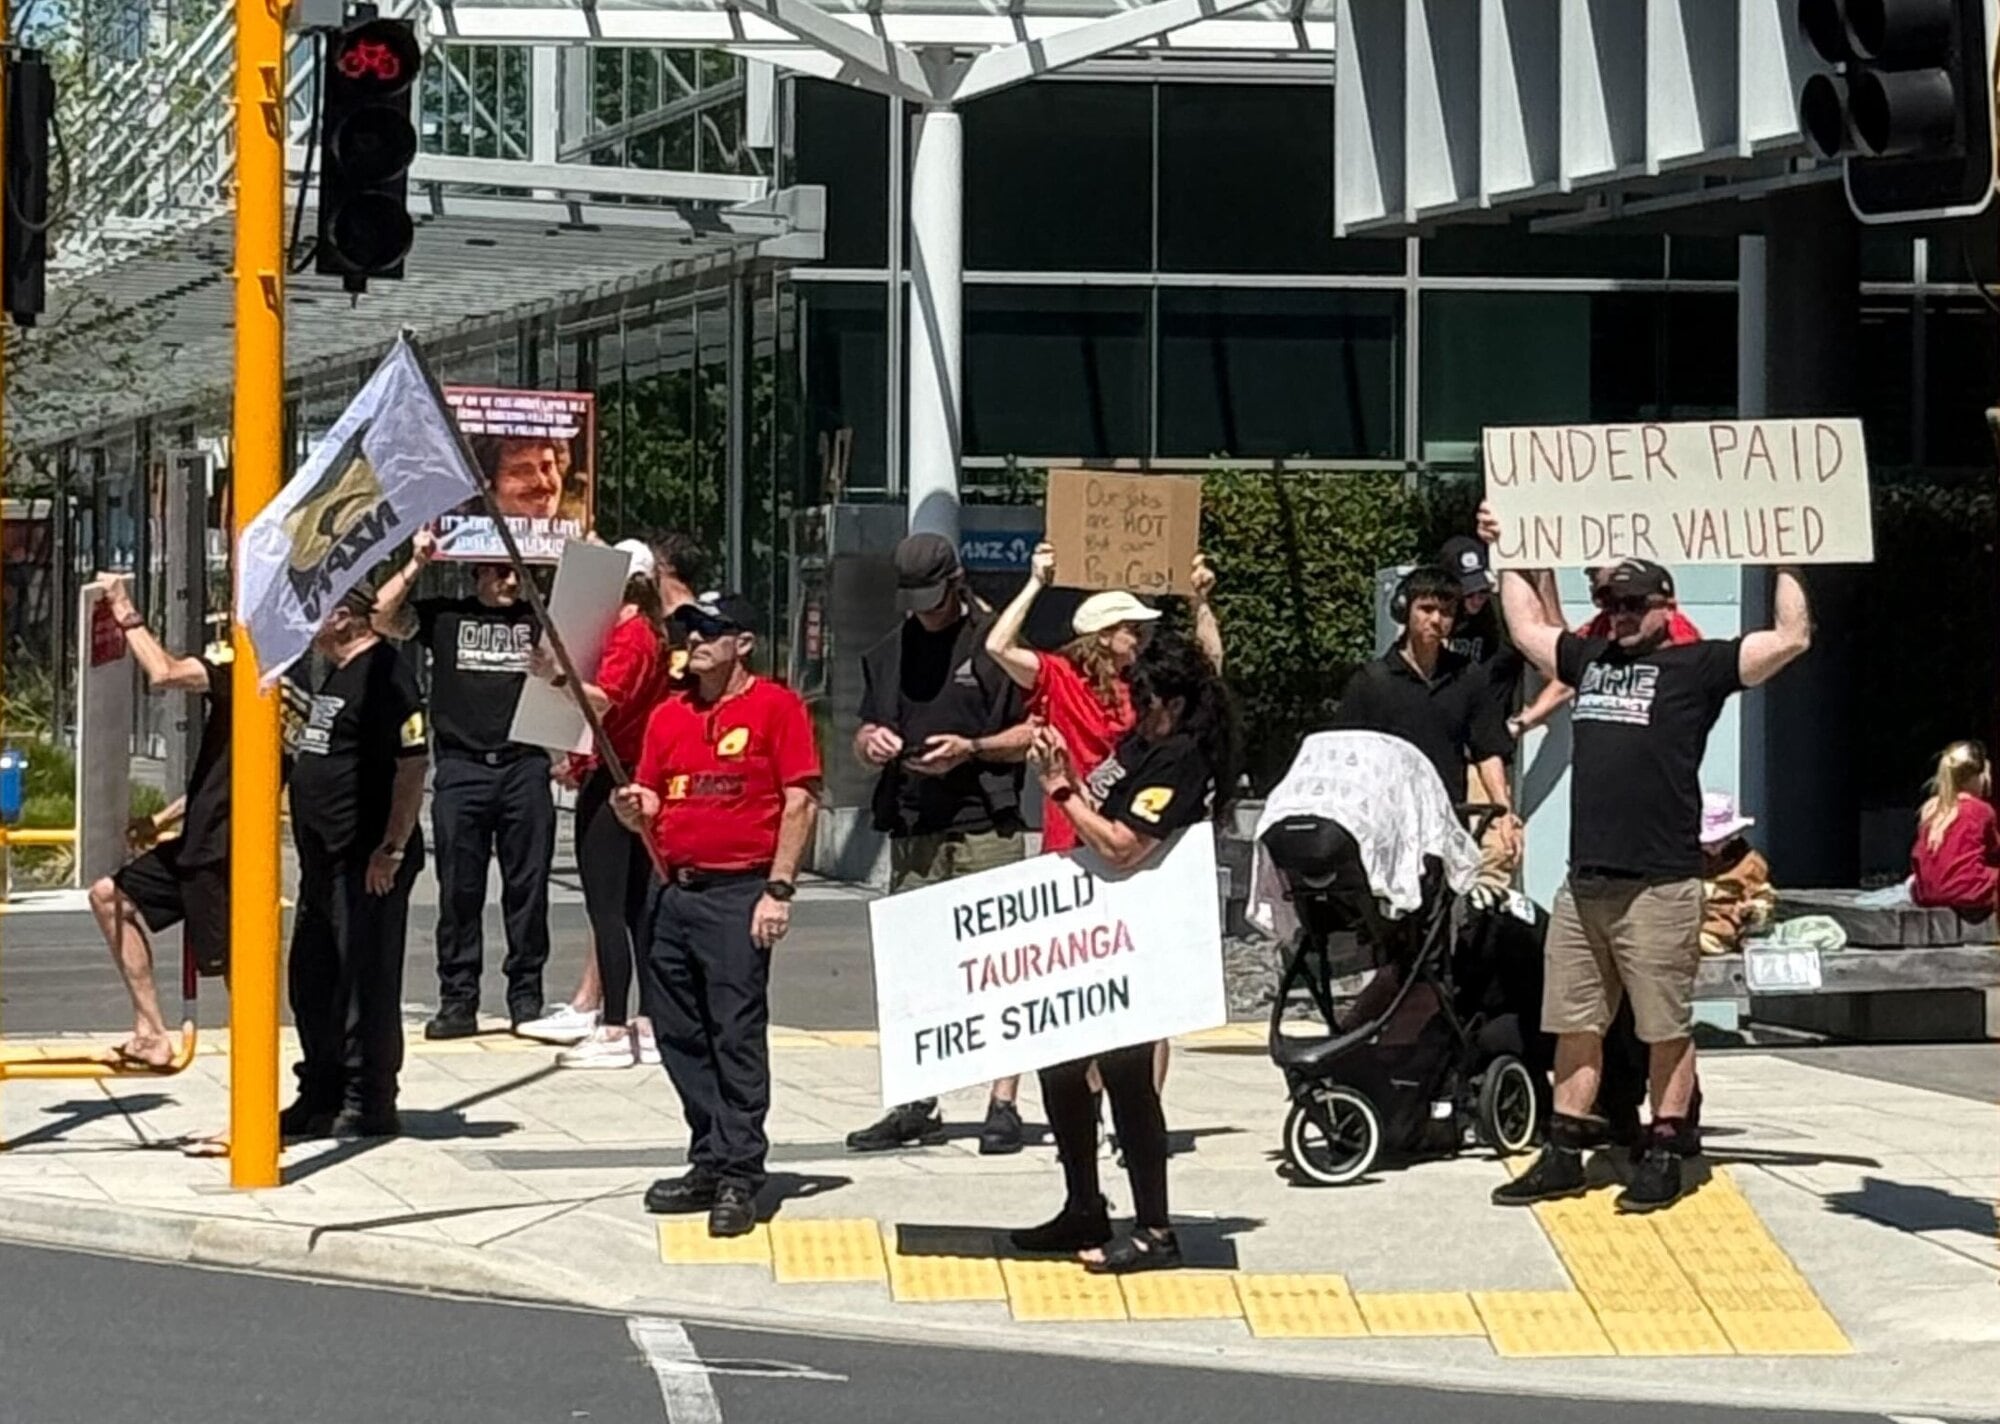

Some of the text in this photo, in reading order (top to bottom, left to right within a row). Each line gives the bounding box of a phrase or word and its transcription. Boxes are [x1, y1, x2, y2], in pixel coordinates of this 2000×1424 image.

[1486, 423, 1843, 486] UNDER PAID
[960, 541, 1004, 559] ANZ
[1123, 512, 1167, 538] HOT
[1672, 506, 1824, 558] VALUED
[953, 872, 1096, 942] REBUILD
[959, 919, 1135, 995] TAURANGA
[915, 976, 1130, 1067] FIRE STATION
